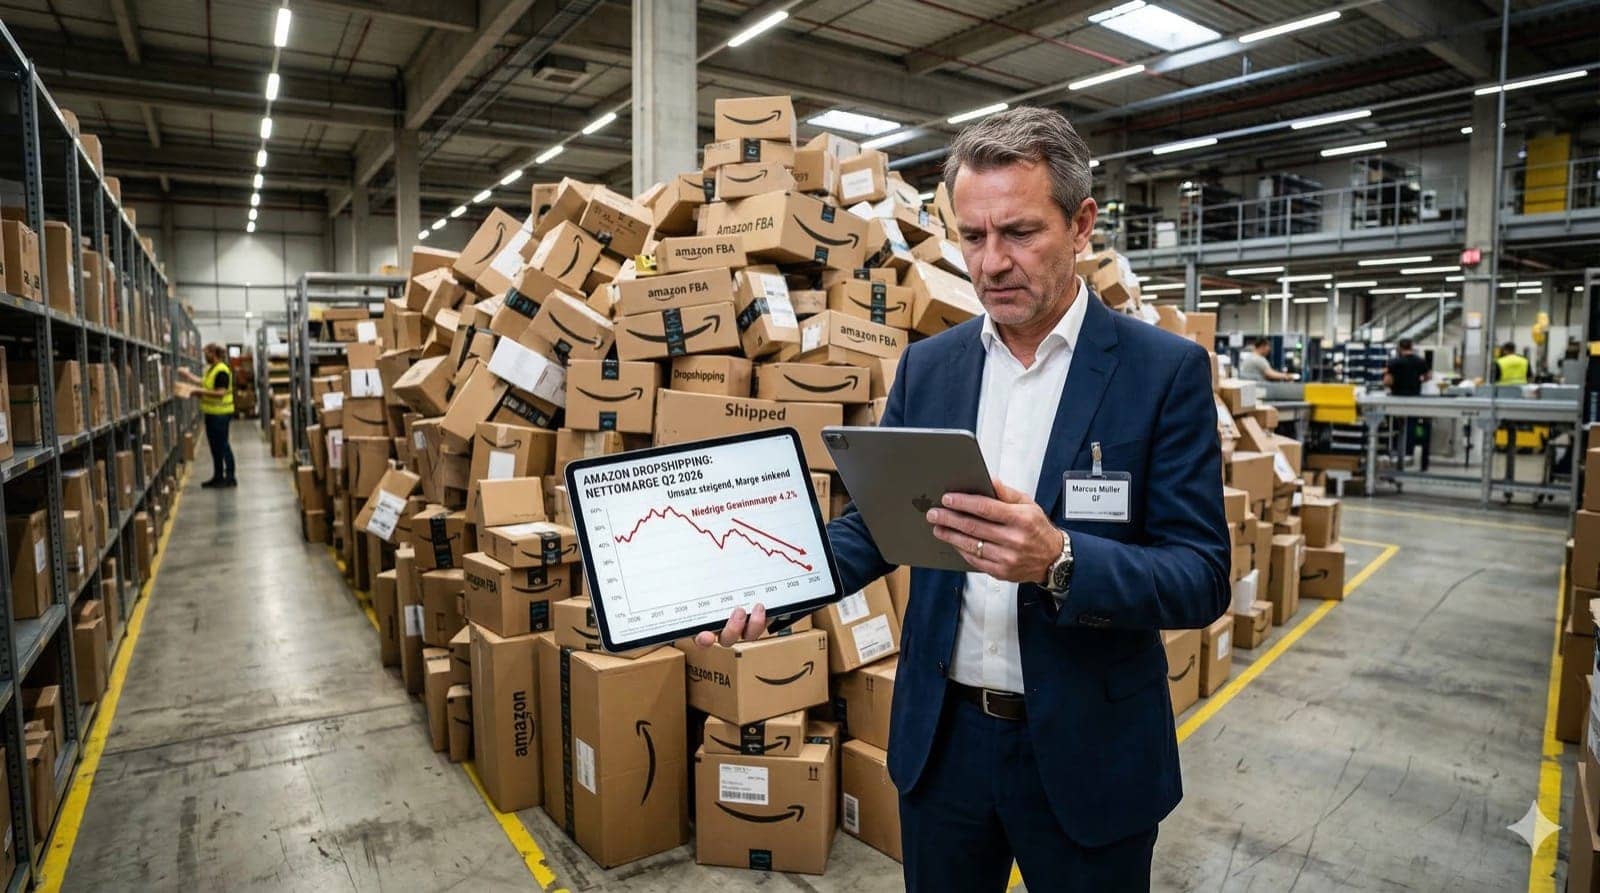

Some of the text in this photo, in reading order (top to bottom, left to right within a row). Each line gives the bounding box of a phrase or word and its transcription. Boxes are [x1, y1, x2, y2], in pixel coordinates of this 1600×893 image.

[717, 216, 774, 235] Amazon FBA
[675, 244, 735, 256] amazon FBA
[648, 282, 709, 298] amazon FBA
[840, 326, 897, 348] amazon FBA
[674, 369, 725, 383] Dropshipping
[725, 403, 786, 422] Shipped
[583, 455, 713, 486] AMAZON DROPSHIPPING:
[586, 470, 704, 499] NETTOMARGE Q2 2026
[667, 468, 791, 499] Umsatz steigend, Marge sinkend
[1072, 485, 1097, 493] Marcus
[691, 489, 798, 517] Niedrige Gewinnmarge 4.2%
[713, 671, 731, 688] FBA
[513, 690, 528, 757] amazon
